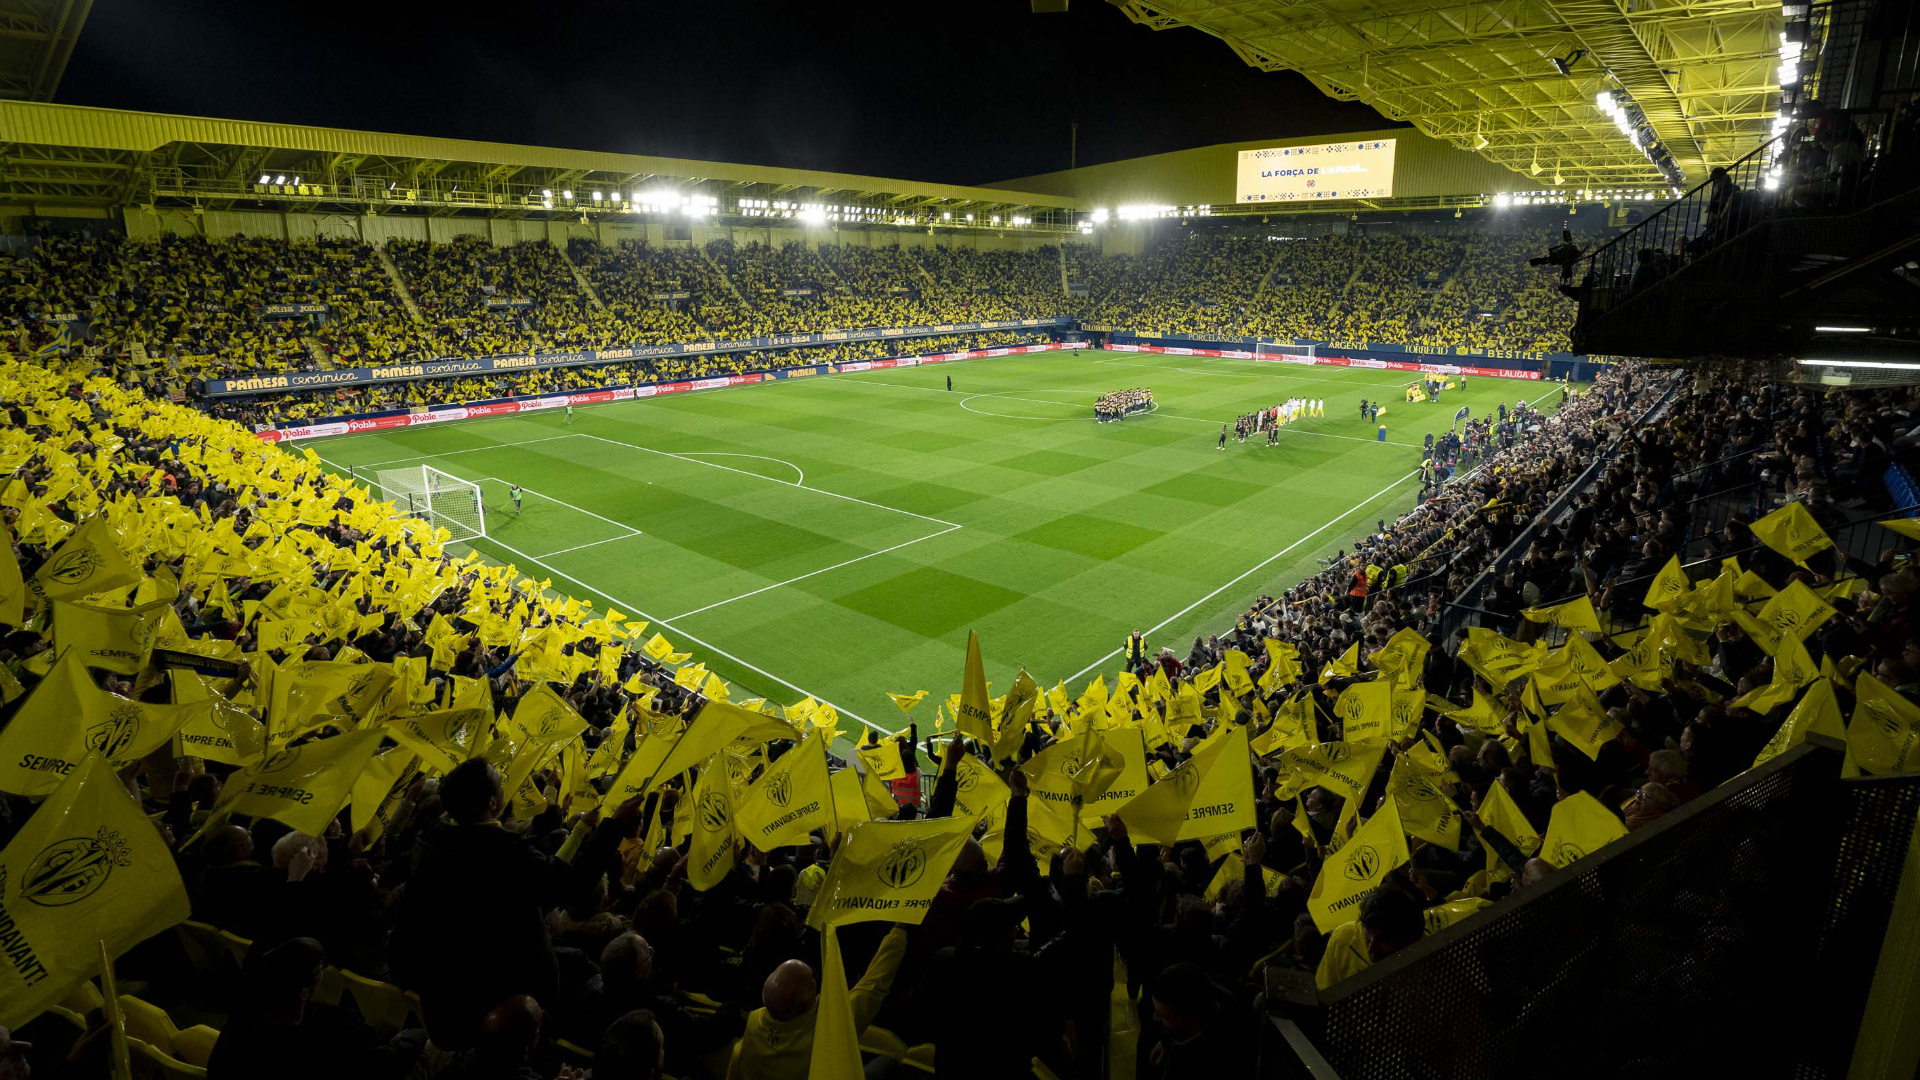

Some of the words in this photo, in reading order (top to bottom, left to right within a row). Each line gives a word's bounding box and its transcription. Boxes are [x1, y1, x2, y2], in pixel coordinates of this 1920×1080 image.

[1262, 170, 1272, 178] LA
[1274, 168, 1305, 178] FORÇA
[1306, 167, 1319, 175] DE
[683, 342, 716, 352] PAMESA
[1328, 341, 1369, 351] ARGENTA
[1404, 345, 1449, 355] TORRECID
[595, 349, 633, 360] PAMESA
[1487, 349, 1544, 361] BESTILE
[493, 356, 536, 369] PAMESA
[371, 365, 424, 379] PAMESA
[787, 367, 817, 378] PAMESA
[1499, 369, 1528, 379] LALIGA
[225, 376, 289, 392] PAMESA
[292, 372, 359, 385] cerámica
[614, 390, 634, 399] Poble
[657, 385, 675, 394] Poble
[569, 394, 590, 403] Poble
[521, 400, 543, 410] Poble
[468, 406, 492, 417] Poble
[412, 413, 437, 424] Poble
[349, 420, 377, 431] Poble
[282, 428, 311, 440] Poble
[19, 754, 76, 776] SEMPRE
